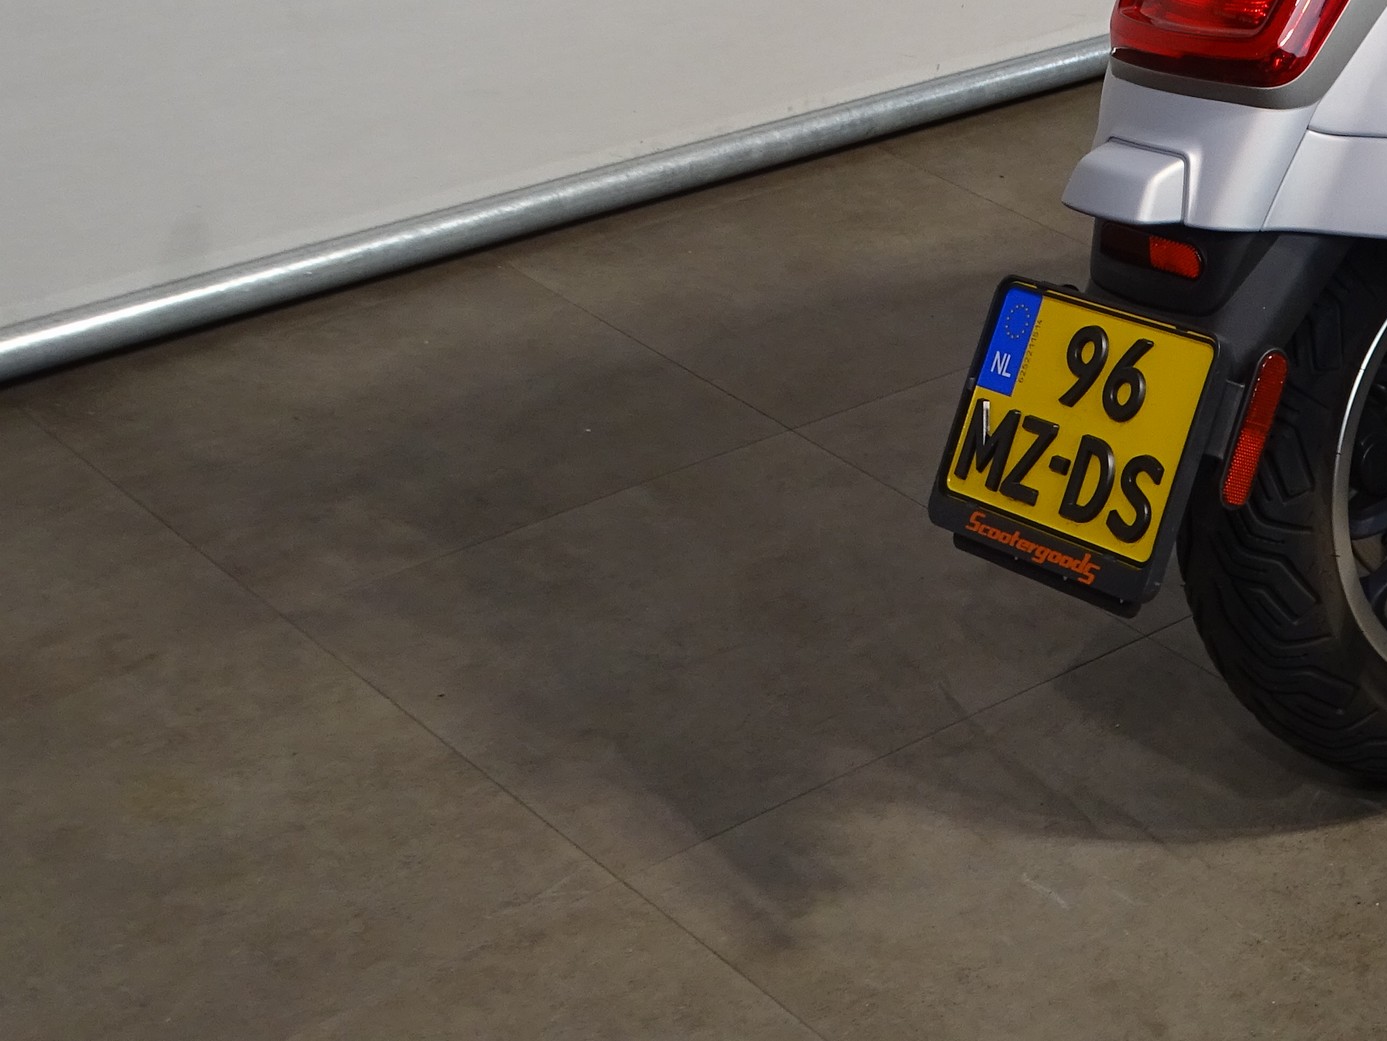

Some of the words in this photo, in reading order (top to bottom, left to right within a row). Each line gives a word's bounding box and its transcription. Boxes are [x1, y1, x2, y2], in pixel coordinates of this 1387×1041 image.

[990, 350, 1011, 378] NL
[1058, 325, 1154, 422] 96
[954, 398, 1165, 544] MZ-DS
